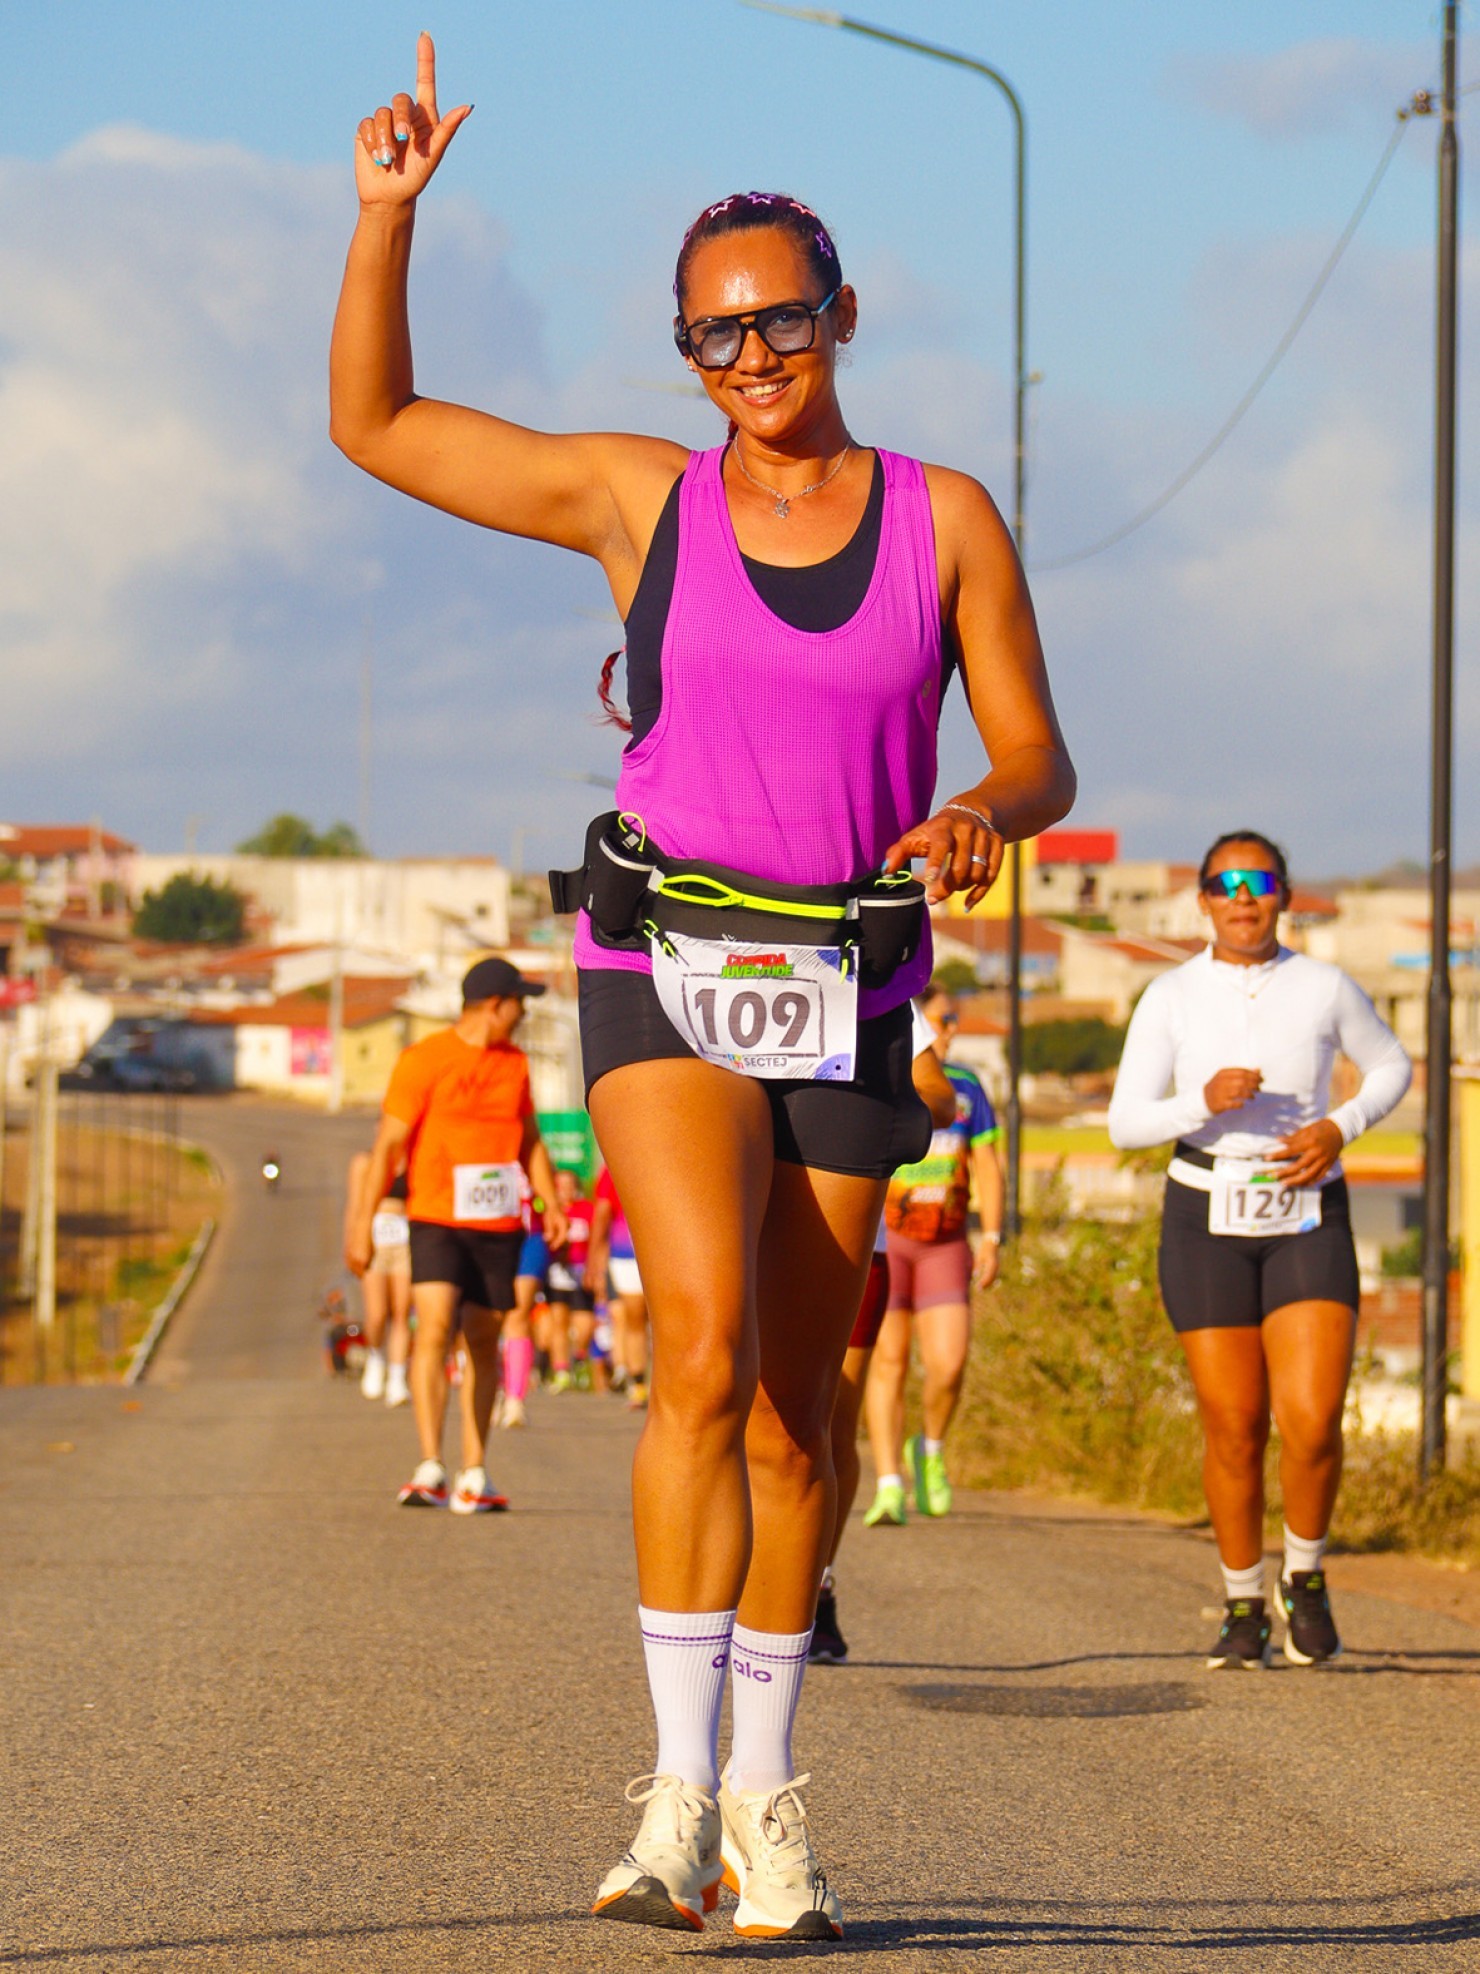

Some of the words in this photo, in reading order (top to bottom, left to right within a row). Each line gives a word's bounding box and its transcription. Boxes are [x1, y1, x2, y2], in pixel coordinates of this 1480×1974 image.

[720, 964, 794, 979] JUVENTUDE
[694, 988, 811, 1049] 109
[743, 1056, 788, 1068] SECTEJ
[1235, 1188, 1297, 1219] 129
